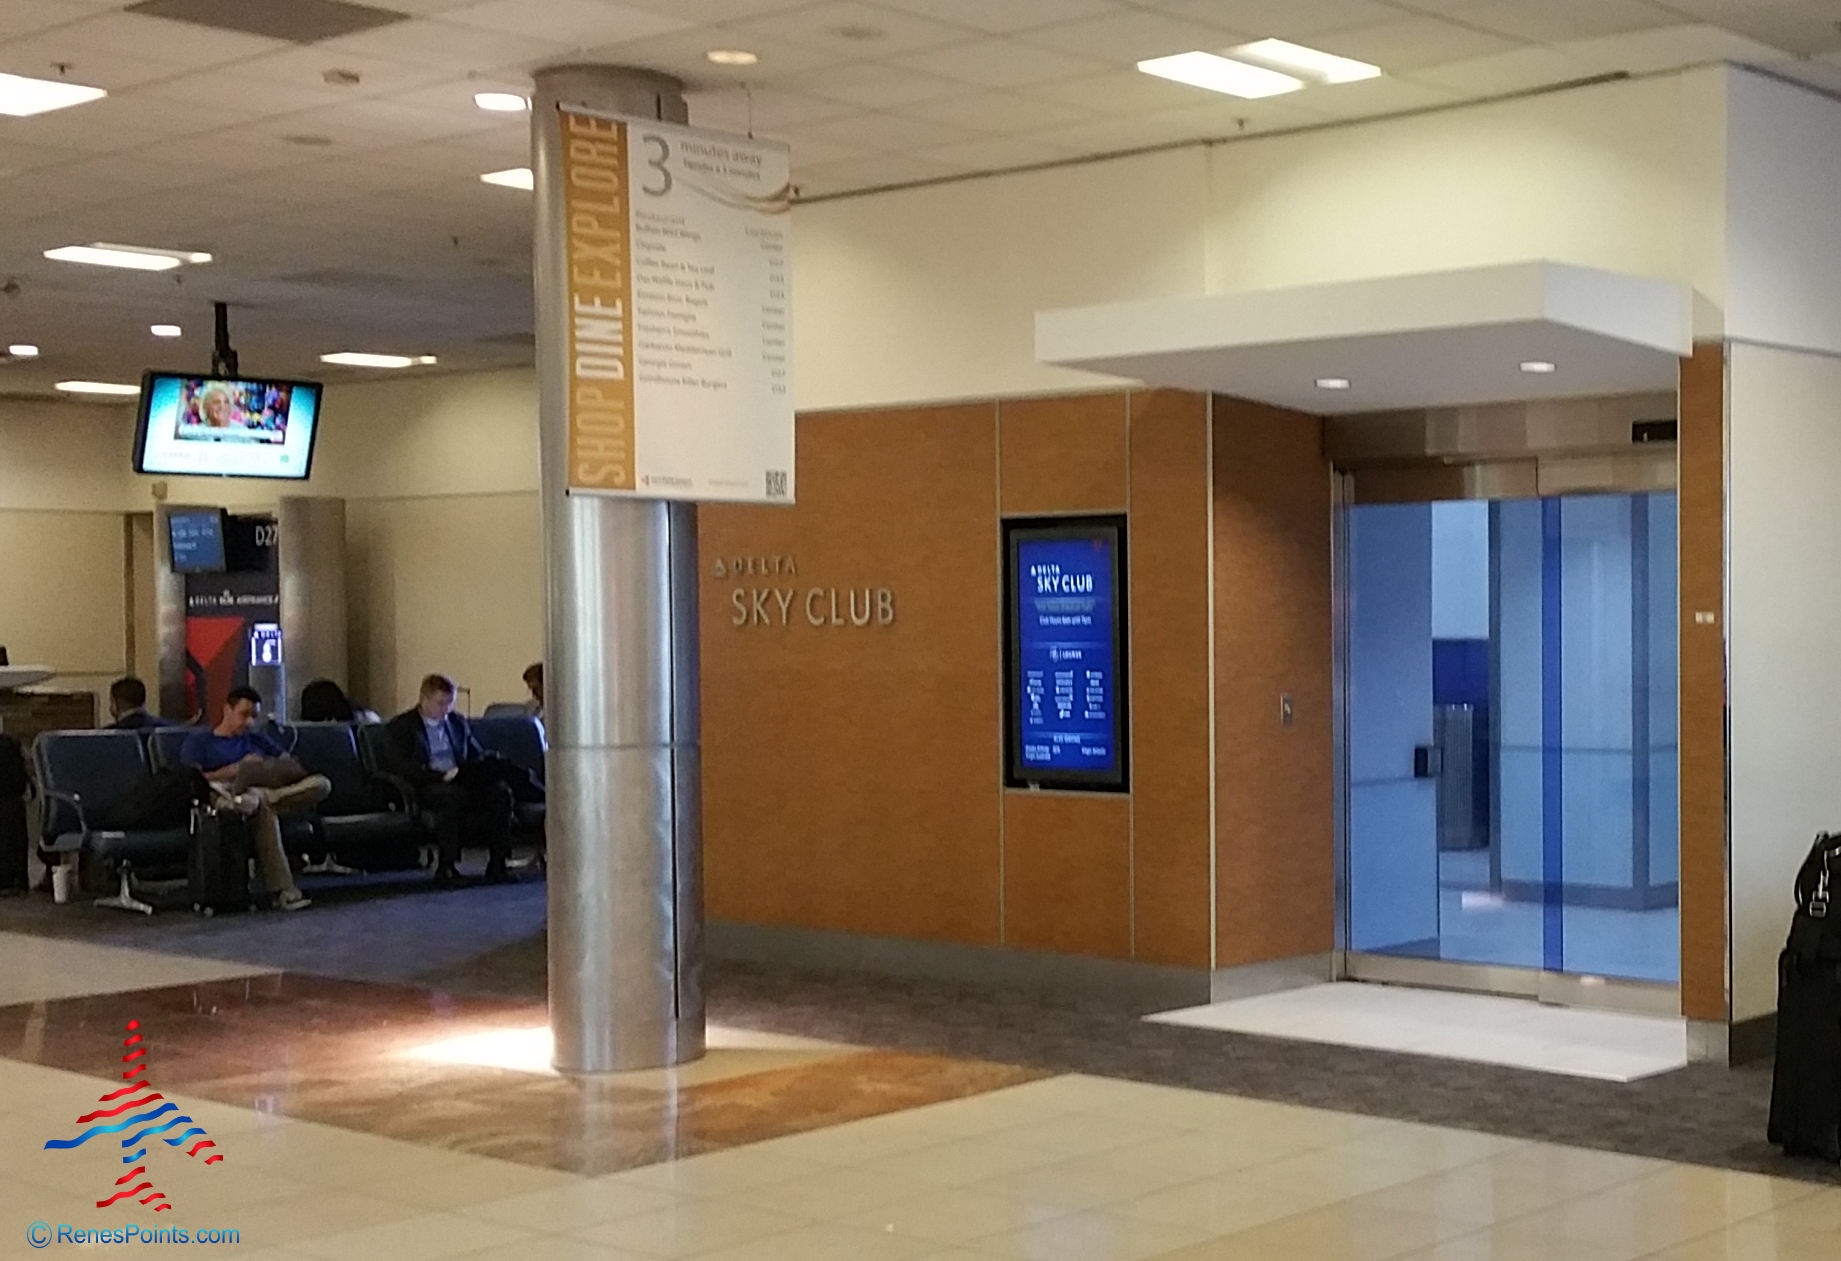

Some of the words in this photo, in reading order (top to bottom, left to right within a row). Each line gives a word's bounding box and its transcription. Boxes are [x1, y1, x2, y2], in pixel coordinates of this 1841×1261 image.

[641, 133, 674, 198] 3
[681, 142, 730, 161] minutes
[731, 151, 762, 168] away
[568, 114, 623, 290] EXPLORE
[573, 293, 625, 382] DINE
[575, 385, 627, 486] SHOP
[255, 525, 278, 548] D27
[731, 554, 798, 576] DELTA
[1037, 574, 1060, 594] SKY
[1061, 573, 1093, 593] CLUB
[731, 588, 794, 627] SKY
[805, 586, 895, 628] CLUB
